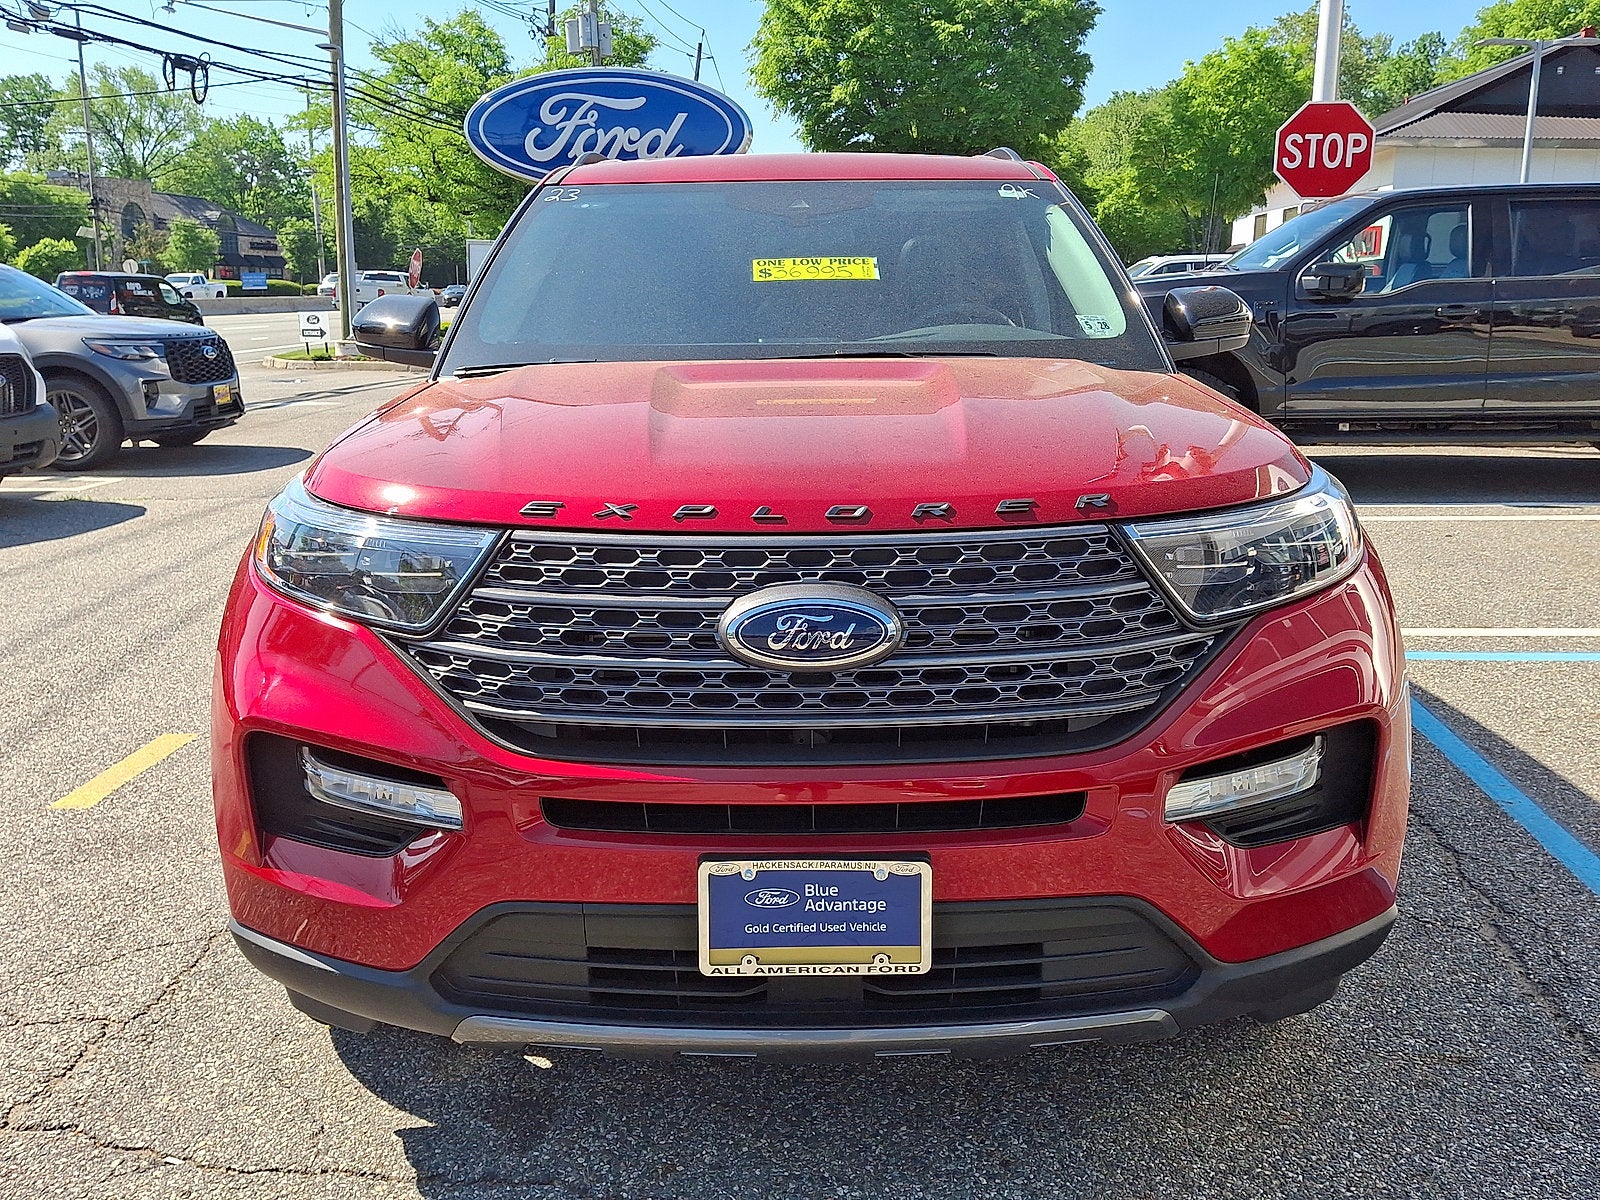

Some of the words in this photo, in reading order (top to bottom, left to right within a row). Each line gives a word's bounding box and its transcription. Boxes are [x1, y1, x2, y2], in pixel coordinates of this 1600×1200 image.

[525, 92, 688, 160] Ford
[1281, 133, 1368, 169] STOP
[544, 188, 581, 202] 23
[757, 259, 786, 267] ONE
[792, 258, 822, 266] LOW
[829, 257, 870, 265] PRICE
[1097, 321, 1110, 330] 28
[519, 492, 1111, 520] EXPLORER
[767, 613, 857, 651] Ford
[804, 883, 839, 897] Blue
[754, 891, 789, 906] Ford
[804, 898, 887, 913] Advantage
[744, 923, 769, 933] Gold
[772, 922, 817, 933] Certified
[819, 922, 847, 932] Used
[849, 921, 887, 932] Vehicle
[710, 967, 747, 975] ALL
[754, 966, 860, 974] AMERICAN
[867, 965, 921, 973] FORD
